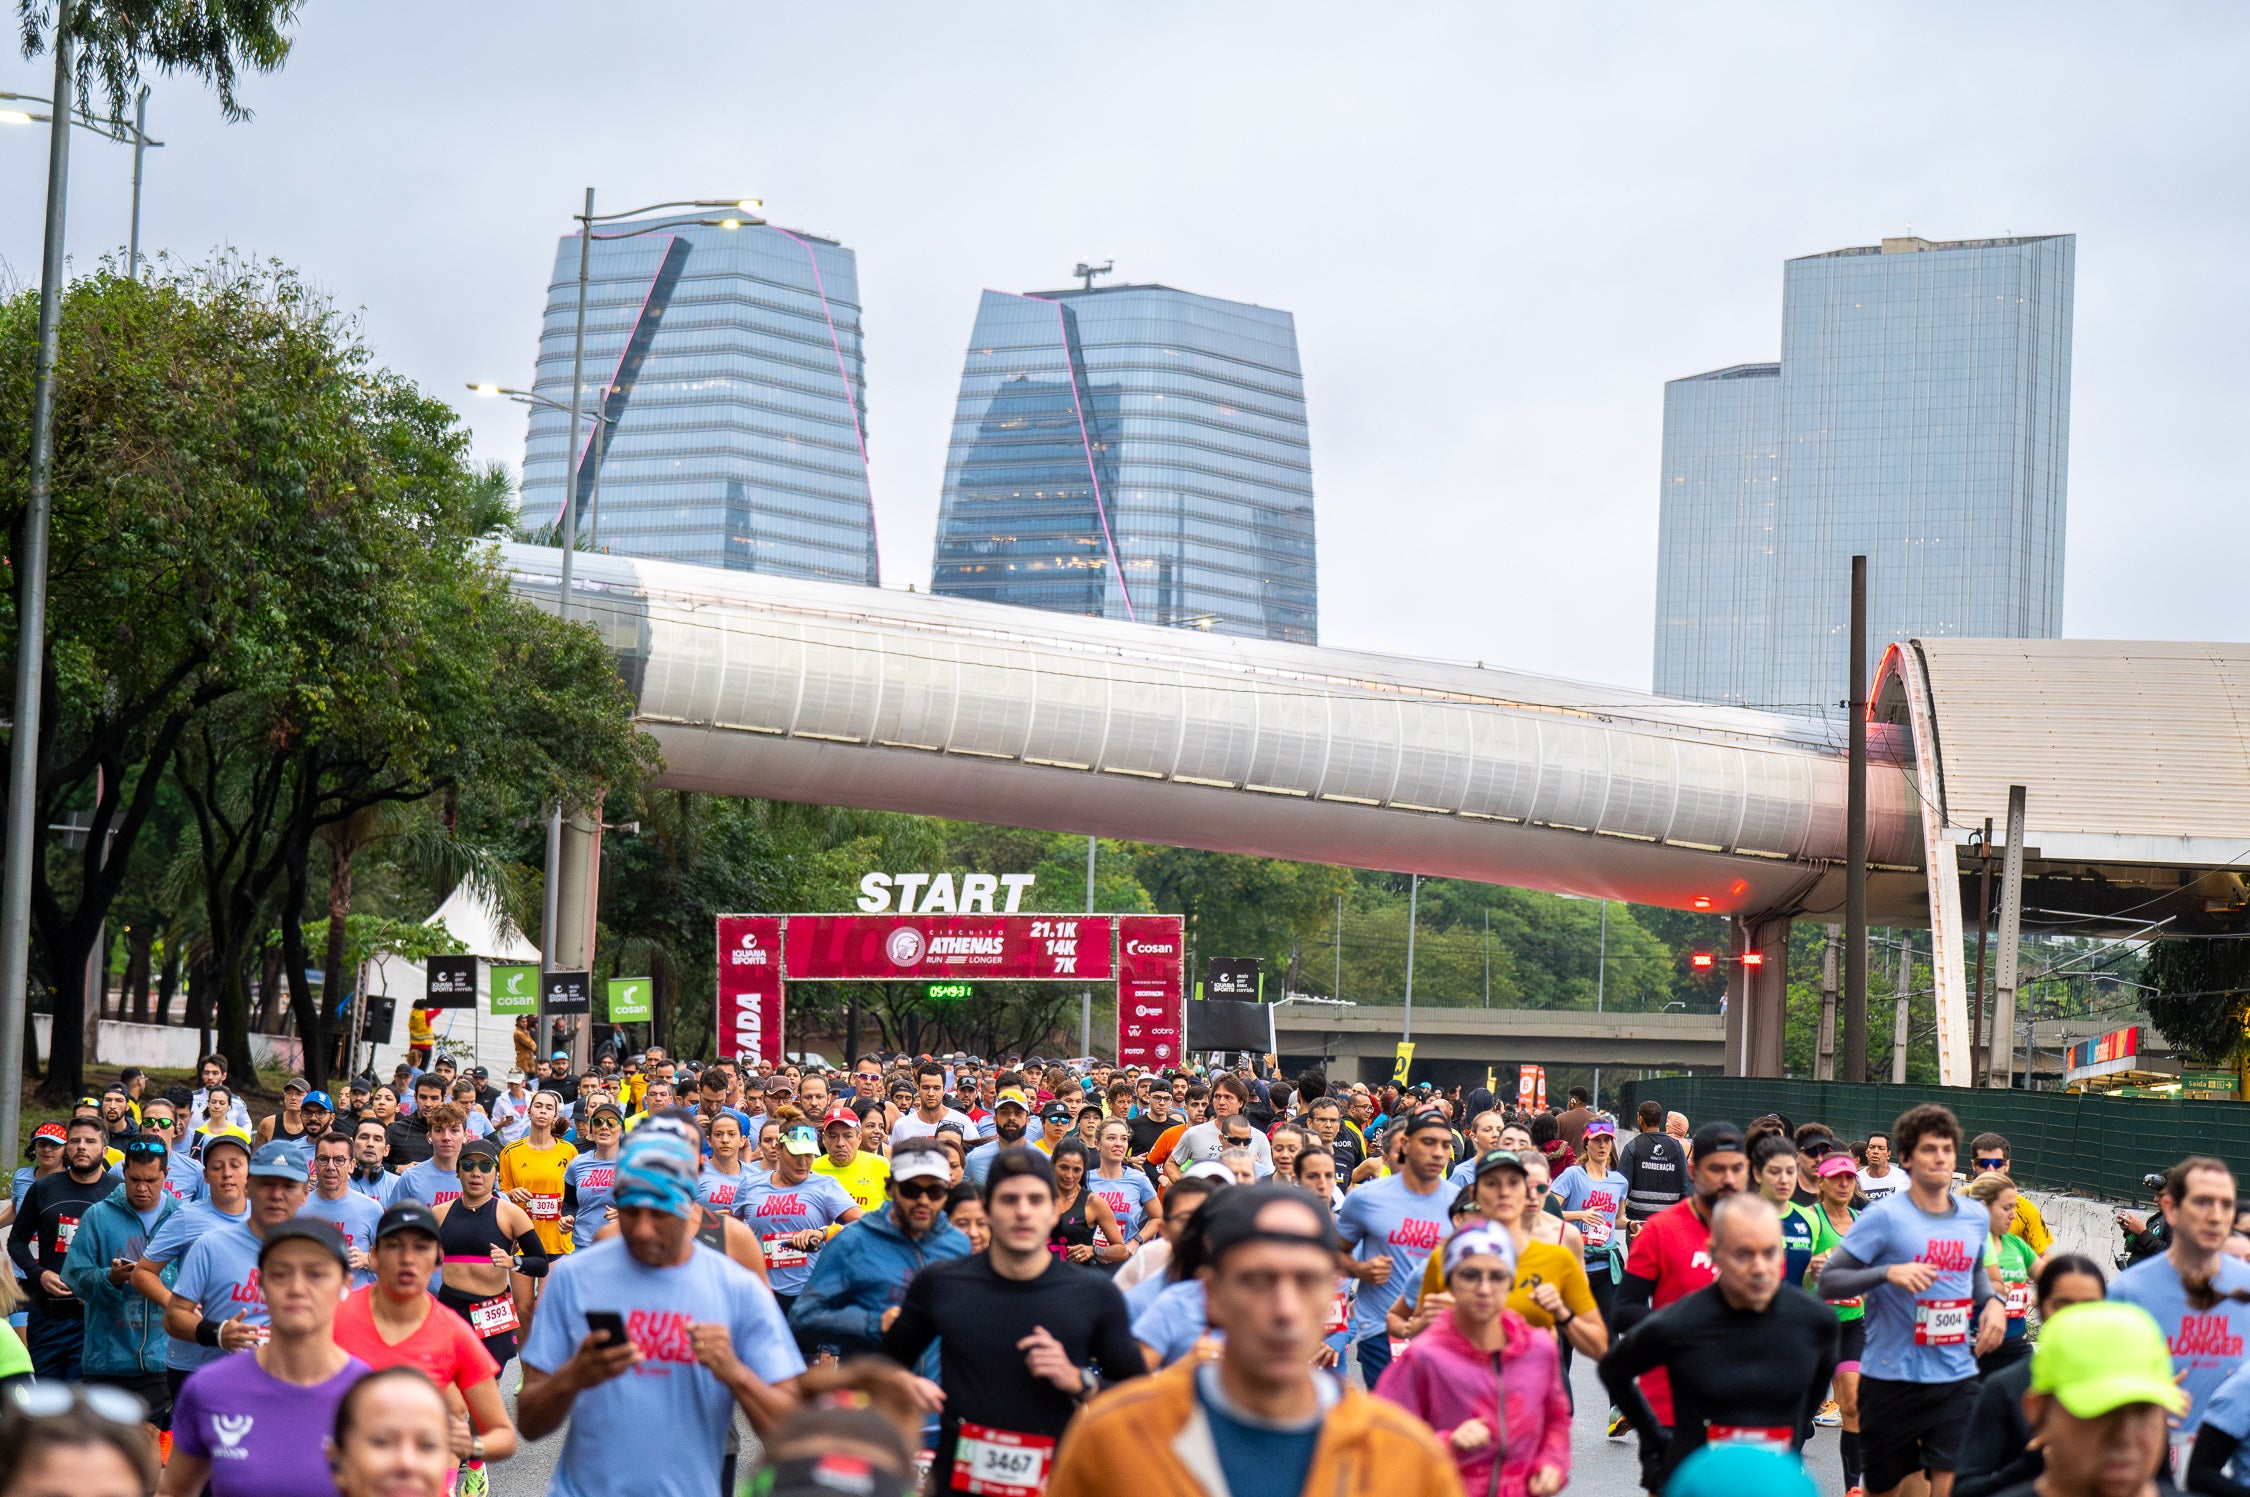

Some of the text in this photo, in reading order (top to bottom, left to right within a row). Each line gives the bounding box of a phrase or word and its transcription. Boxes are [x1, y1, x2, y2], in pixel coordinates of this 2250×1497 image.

[857, 873, 1036, 914] START
[1029, 921, 1078, 938] 21.1K
[732, 949, 767, 958] IGUANA
[927, 937, 1005, 955] ATHENAS
[1045, 940, 1078, 956] 14K
[1137, 944, 1173, 954] cosan
[732, 957, 767, 965] SPORTS
[926, 956, 1003, 964] RUN LONGER
[1053, 957, 1078, 974] 7K
[496, 996, 535, 1006] cosan
[614, 1005, 648, 1015] cosan
[580, 1178, 615, 1188] LONGE
[767, 1193, 799, 1206] RUN
[1590, 1190, 1613, 1203] RUN
[536, 1201, 555, 1211] 3076
[756, 1203, 808, 1218] LONGER
[1402, 1218, 1441, 1237] RUN
[1926, 1238, 1965, 1259] RUN
[484, 1305, 508, 1322] 3593
[1934, 1313, 1962, 1328] 5004
[2181, 1314, 2230, 1337] RUN
[985, 1449, 1033, 1473] 3467
